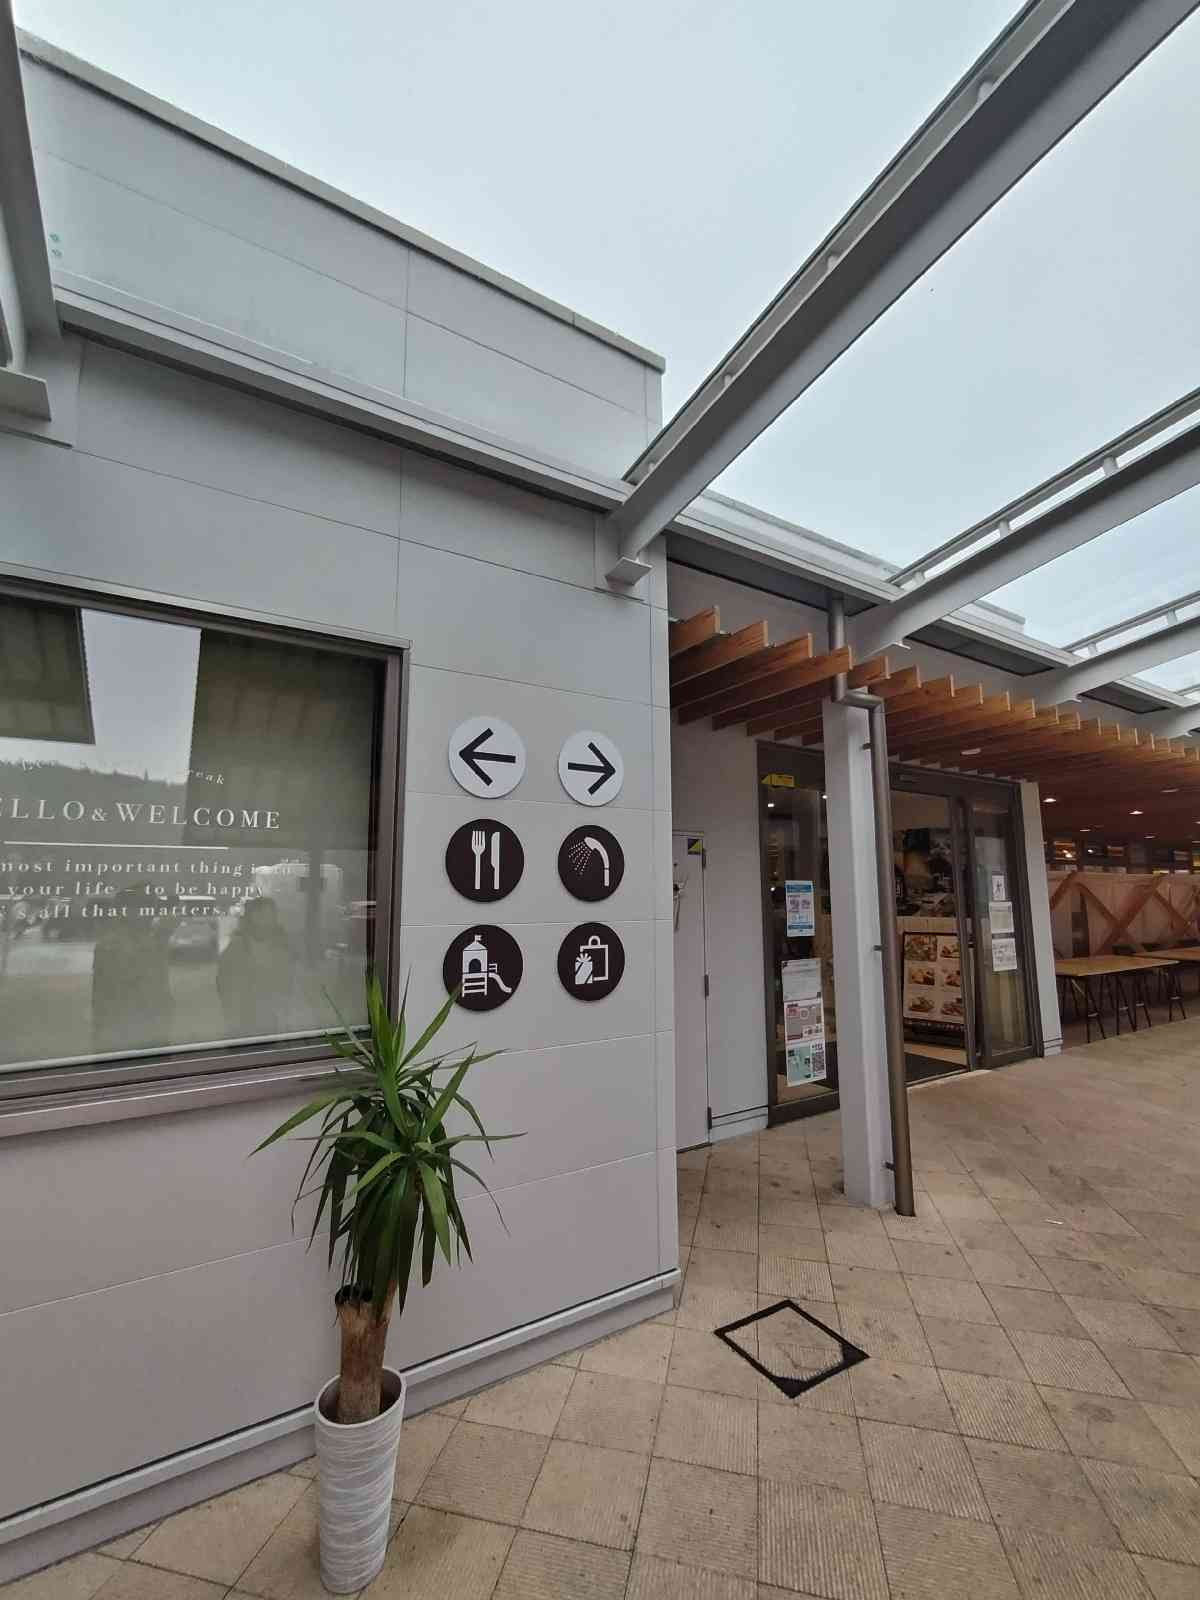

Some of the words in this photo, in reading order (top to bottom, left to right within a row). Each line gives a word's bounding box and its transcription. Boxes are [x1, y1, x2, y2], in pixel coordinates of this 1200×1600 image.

[0, 798, 85, 820] LLO
[115, 802, 280, 829] WELCOME
[65, 859, 180, 876] important
[190, 860, 242, 877] thing
[8, 884, 64, 897] your
[75, 880, 115, 895] life
[145, 882, 164, 896] to
[175, 881, 197, 896] be
[207, 882, 263, 898] happy
[81, 903, 128, 918] that
